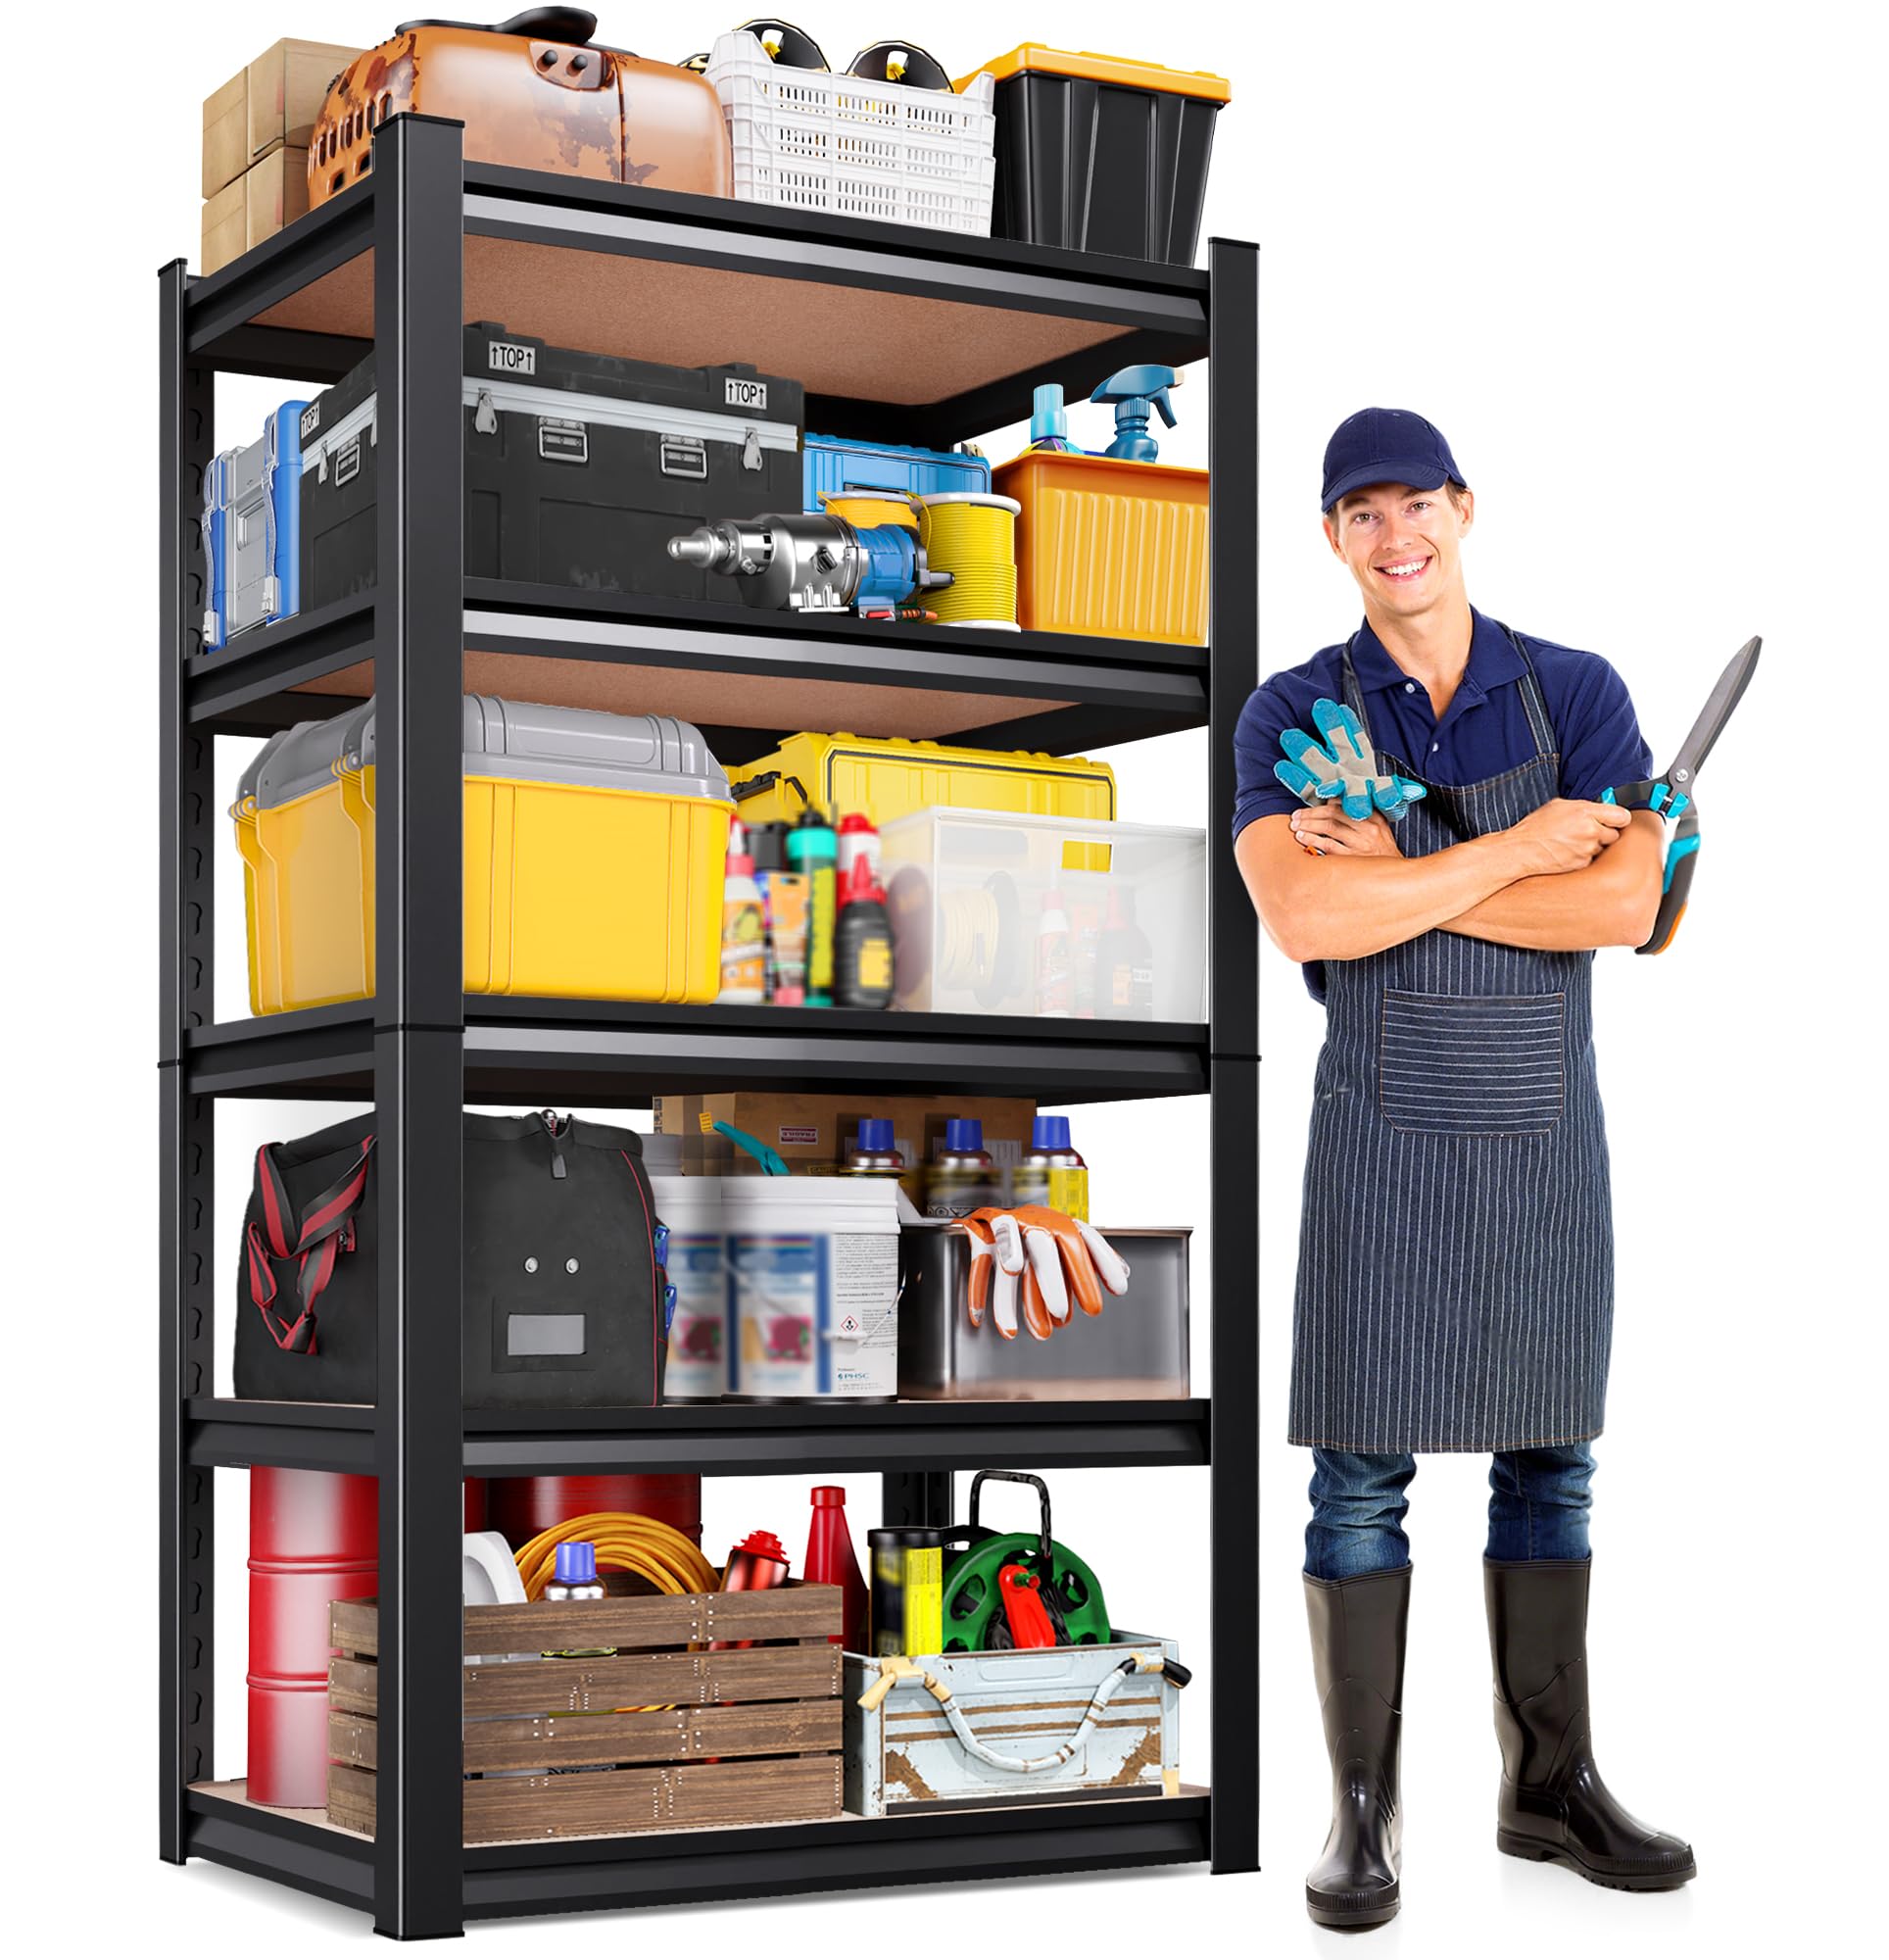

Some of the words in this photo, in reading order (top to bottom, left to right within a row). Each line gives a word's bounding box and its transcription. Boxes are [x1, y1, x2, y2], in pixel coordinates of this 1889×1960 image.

[500, 346, 525, 368] TOP
[735, 382, 757, 404] TOP
[305, 409, 315, 432] TOP
